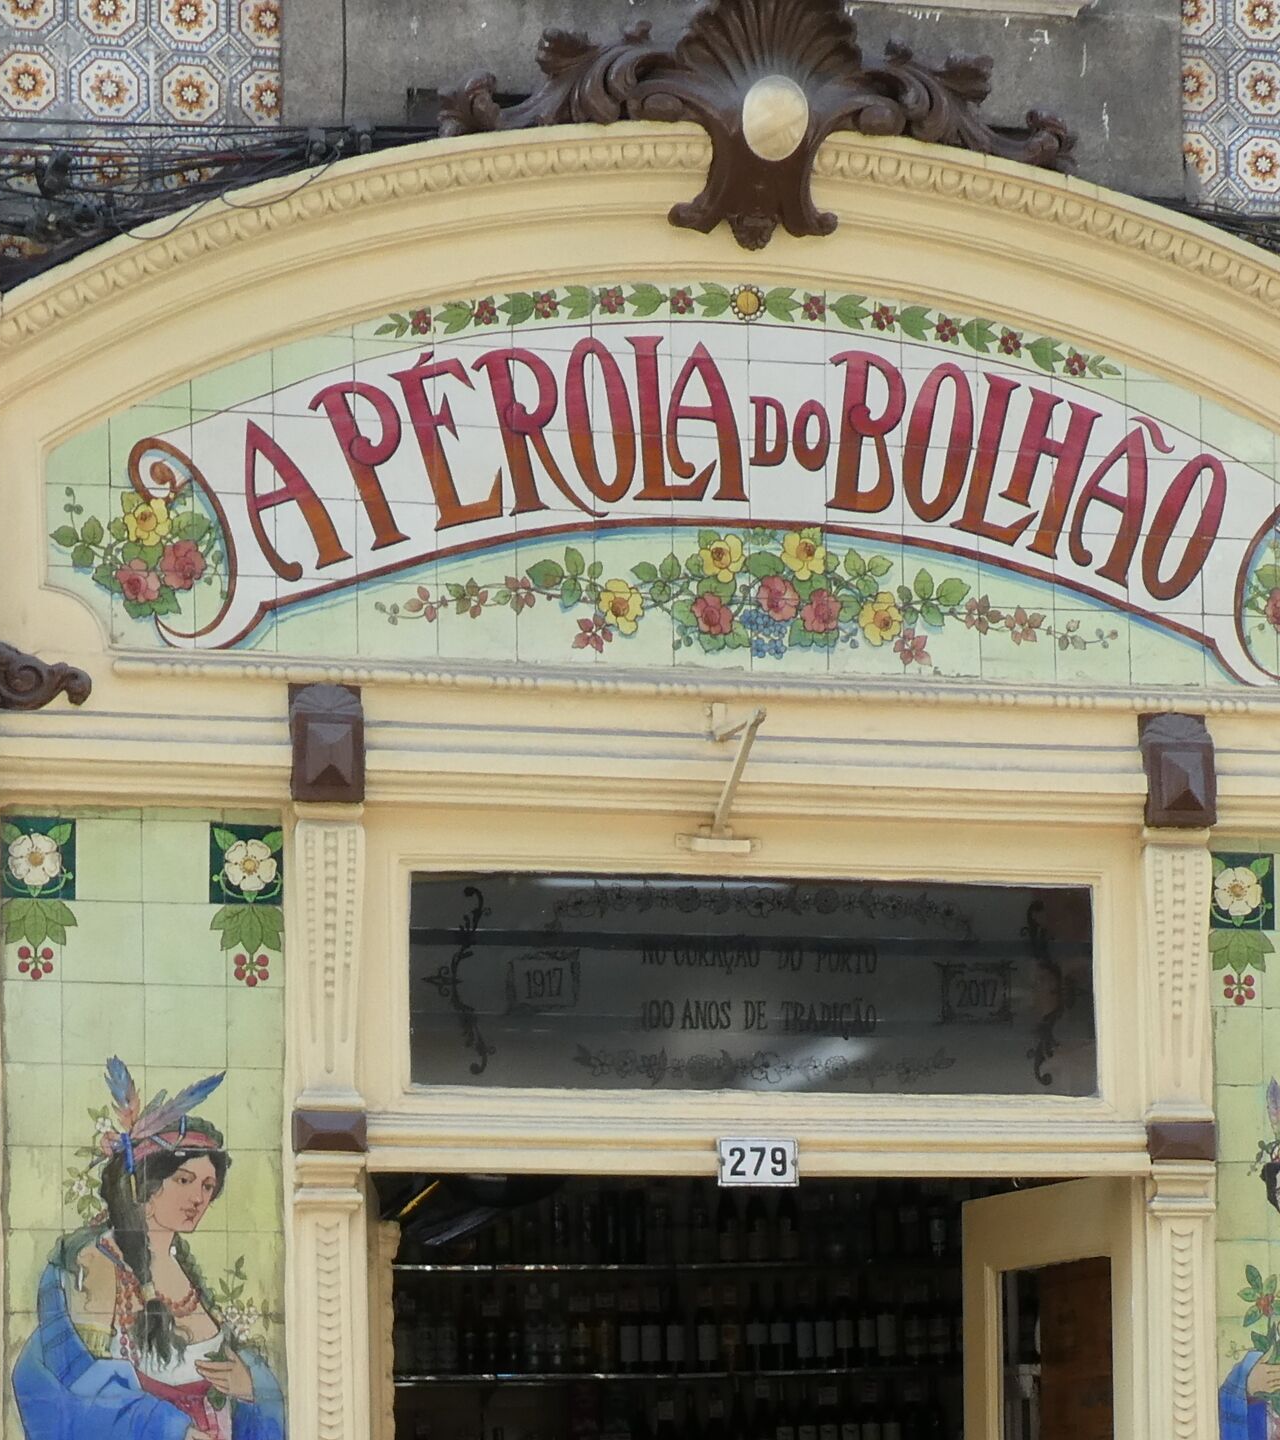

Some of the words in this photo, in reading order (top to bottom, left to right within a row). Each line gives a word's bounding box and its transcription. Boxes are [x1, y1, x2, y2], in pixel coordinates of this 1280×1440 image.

[245, 418, 354, 582] A
[308, 334, 750, 552] PÉROLA
[749, 395, 831, 472] DO
[825, 350, 1227, 601] BOLHÃO
[640, 941, 668, 965] NO
[672, 938, 761, 975] CORAÇÃO
[777, 942, 803, 972] DO
[815, 943, 878, 974] PORTO
[524, 967, 564, 999] 1917
[956, 977, 999, 1007] 2017
[640, 1002, 675, 1030] 100
[680, 1001, 732, 1031] ANOS
[743, 1003, 768, 1031] DE
[780, 998, 878, 1039] TRADIÇÃO
[728, 1146, 788, 1178] 279
